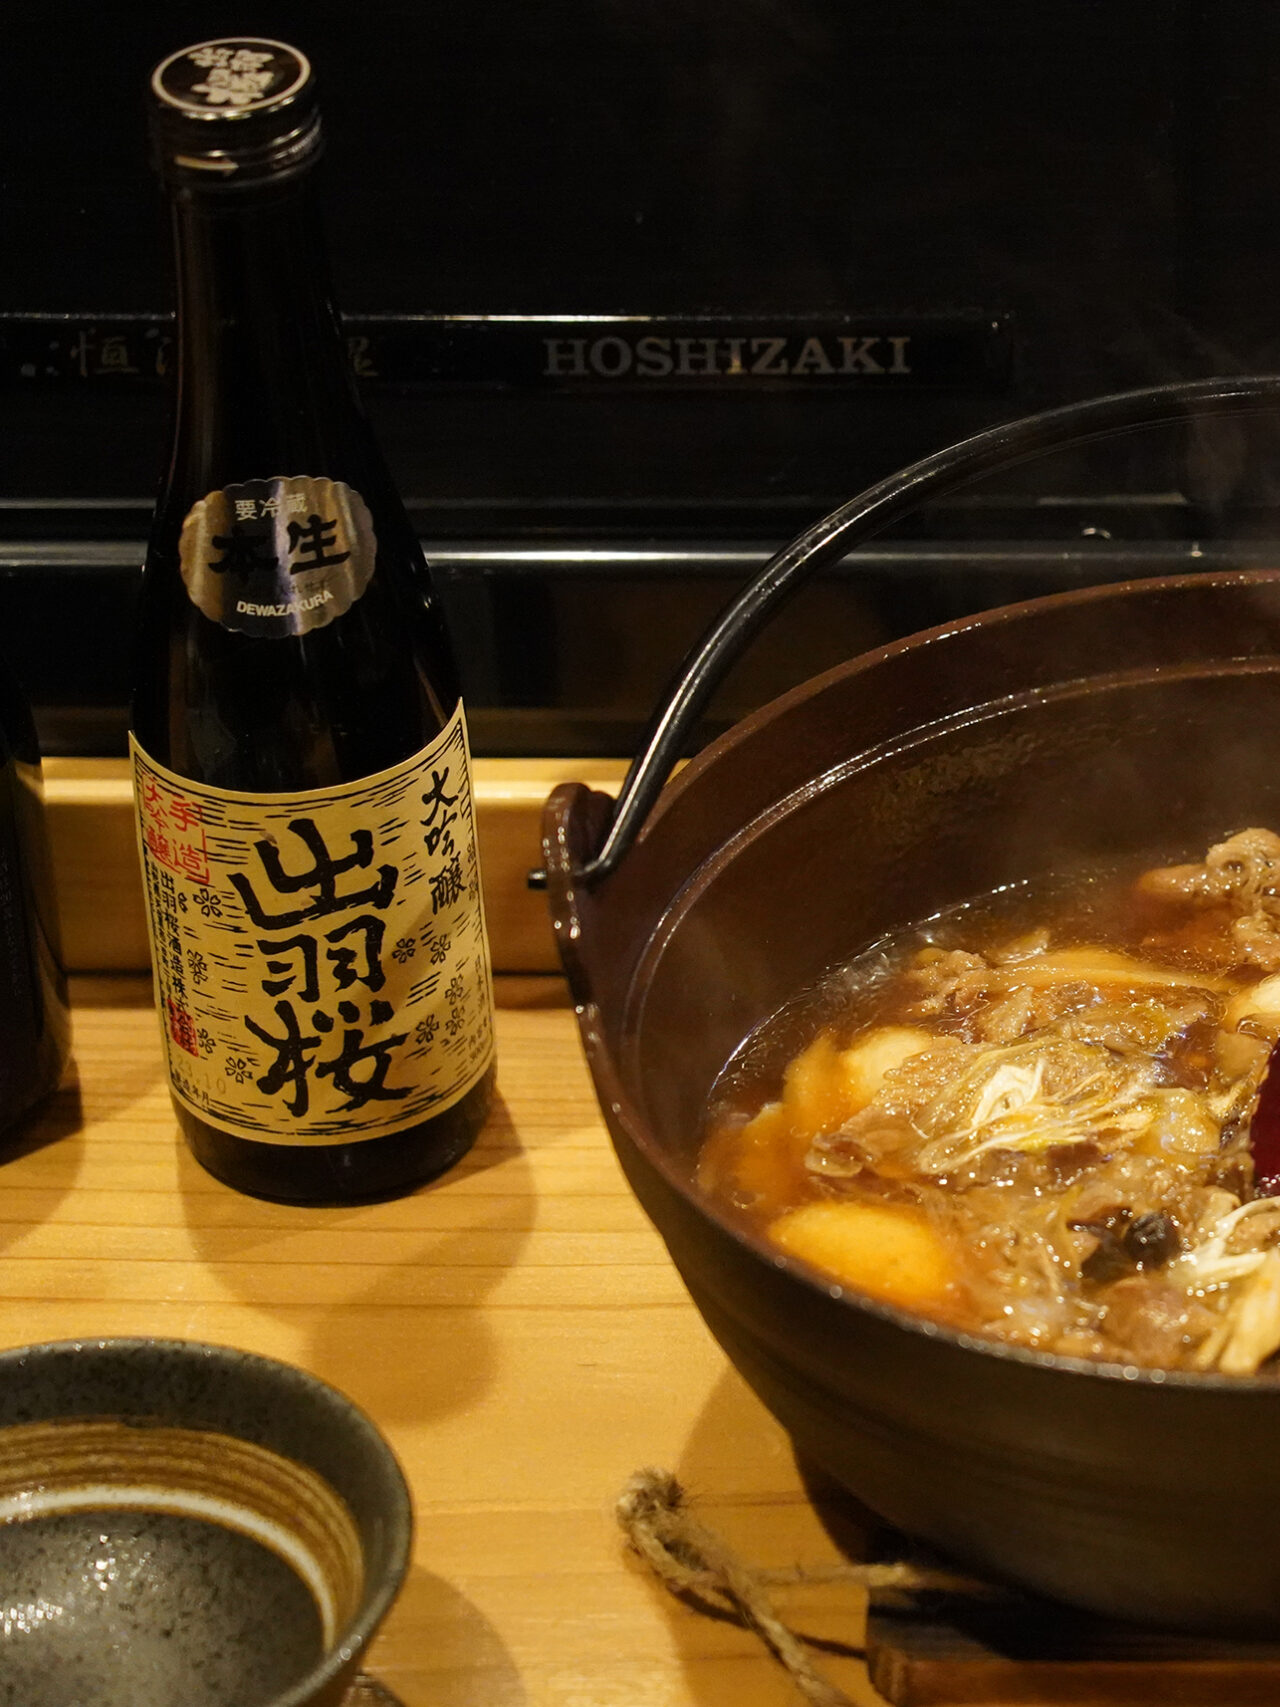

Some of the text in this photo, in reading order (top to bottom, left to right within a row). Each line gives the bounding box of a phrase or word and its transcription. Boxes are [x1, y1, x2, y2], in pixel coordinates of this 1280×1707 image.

[542, 336, 912, 378] HOSHIZAKI
[234, 493, 308, 521] 要冷蔵
[208, 514, 352, 587] 本生
[236, 590, 334, 617] DEWAZAKURA
[226, 818, 412, 1118] 出羽桜
